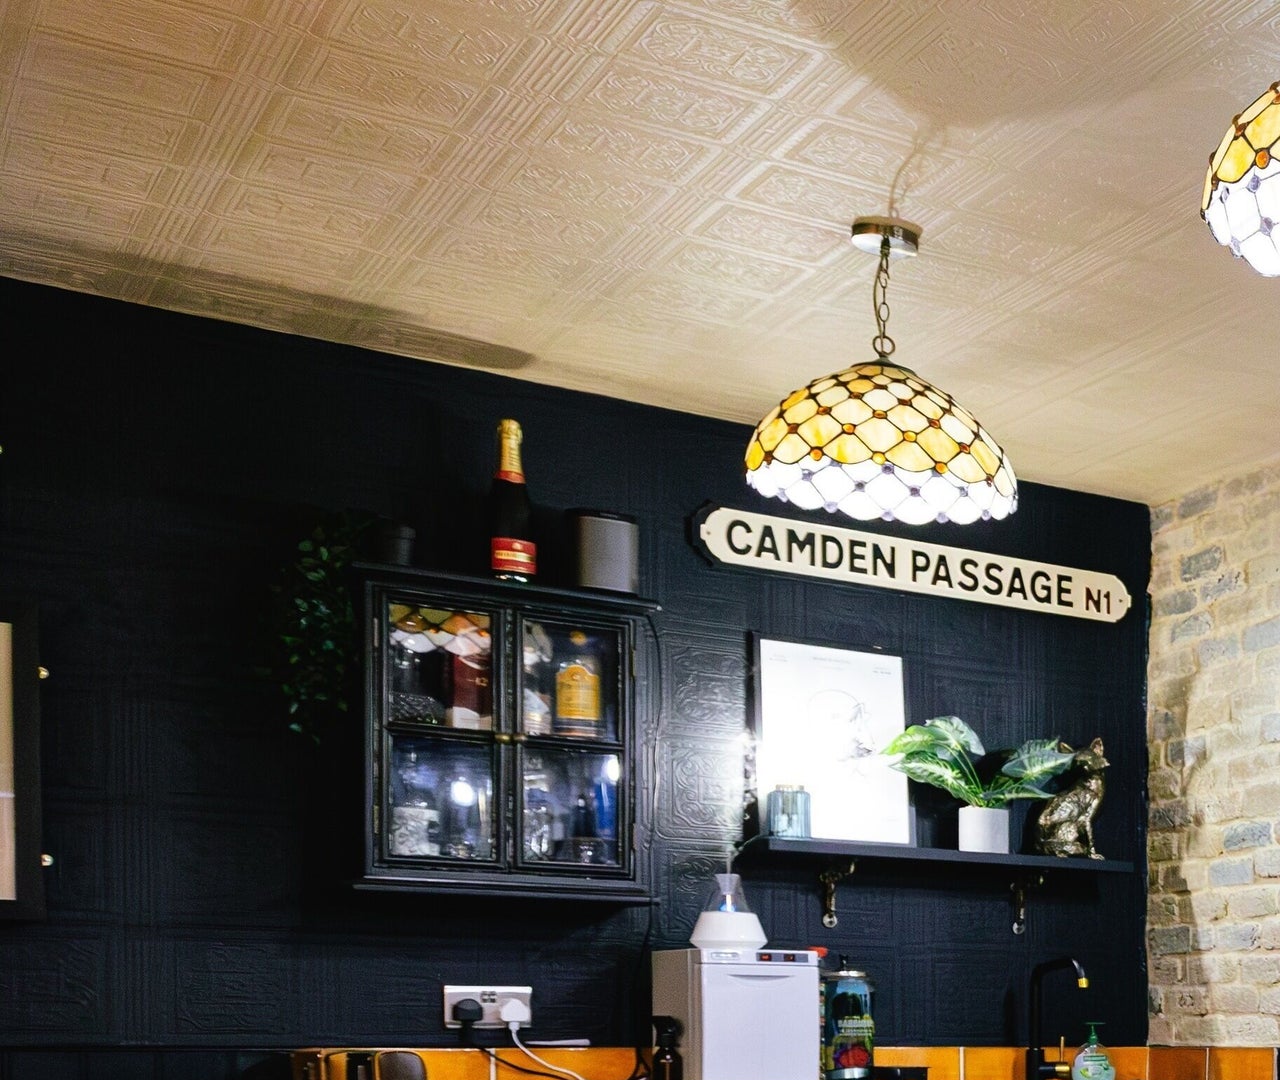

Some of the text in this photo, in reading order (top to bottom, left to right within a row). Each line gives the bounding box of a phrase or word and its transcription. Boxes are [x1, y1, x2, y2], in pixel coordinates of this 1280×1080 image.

[726, 519, 1112, 615] CAMDEN PASSAGE N1
